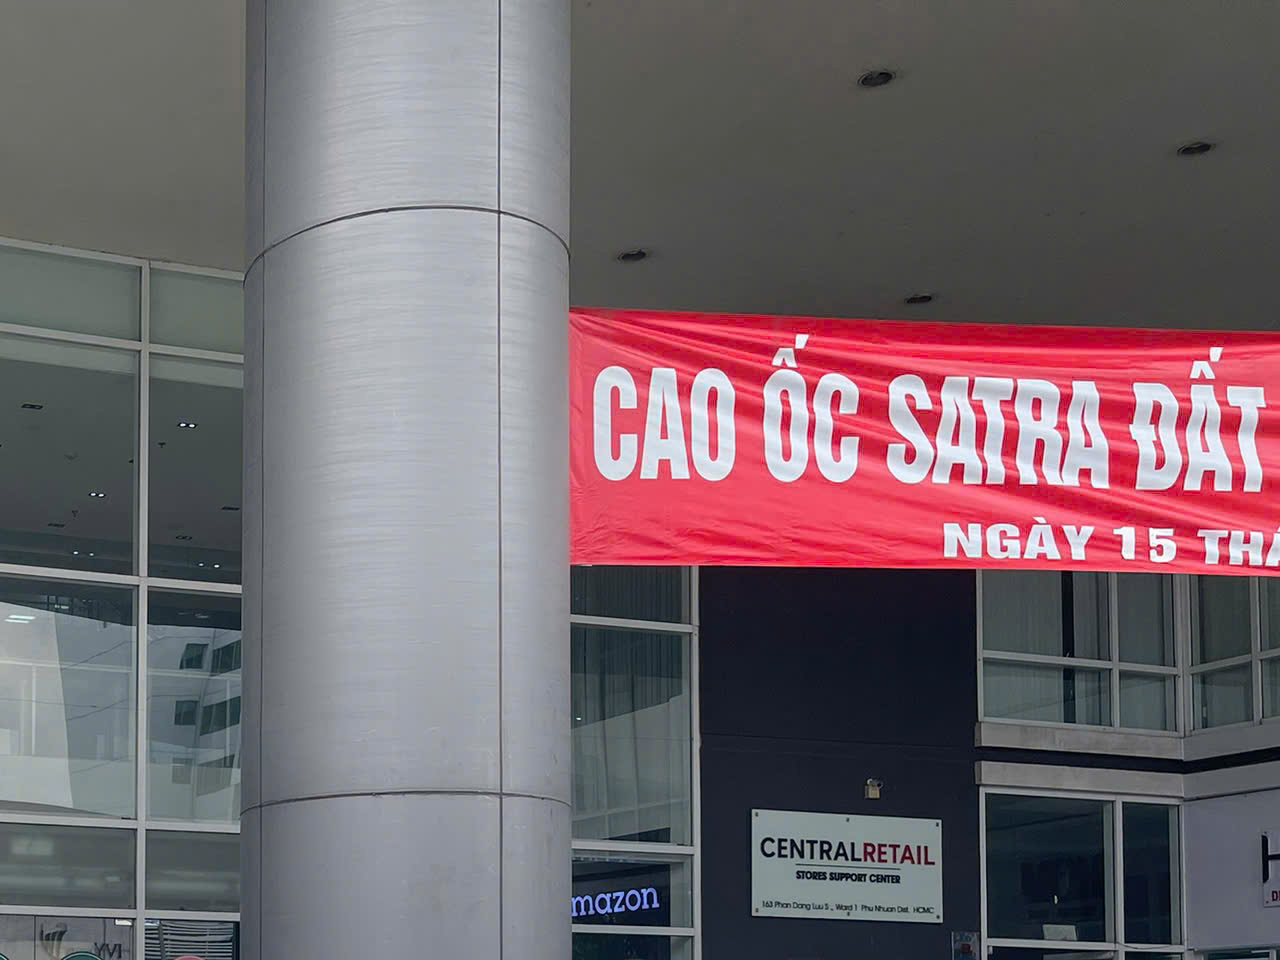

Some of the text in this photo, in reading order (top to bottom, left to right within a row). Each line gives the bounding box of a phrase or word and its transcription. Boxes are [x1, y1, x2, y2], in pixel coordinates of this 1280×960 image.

[593, 334, 1267, 492] CAO ỐC SATRA ĐẤT
[943, 517, 1095, 559] NGÀY
[1113, 526, 1177, 564] 15
[796, 870, 901, 884] STORES SUPPORT CENTER
[774, 901, 792, 909] Phan
[792, 901, 811, 911] Dang
